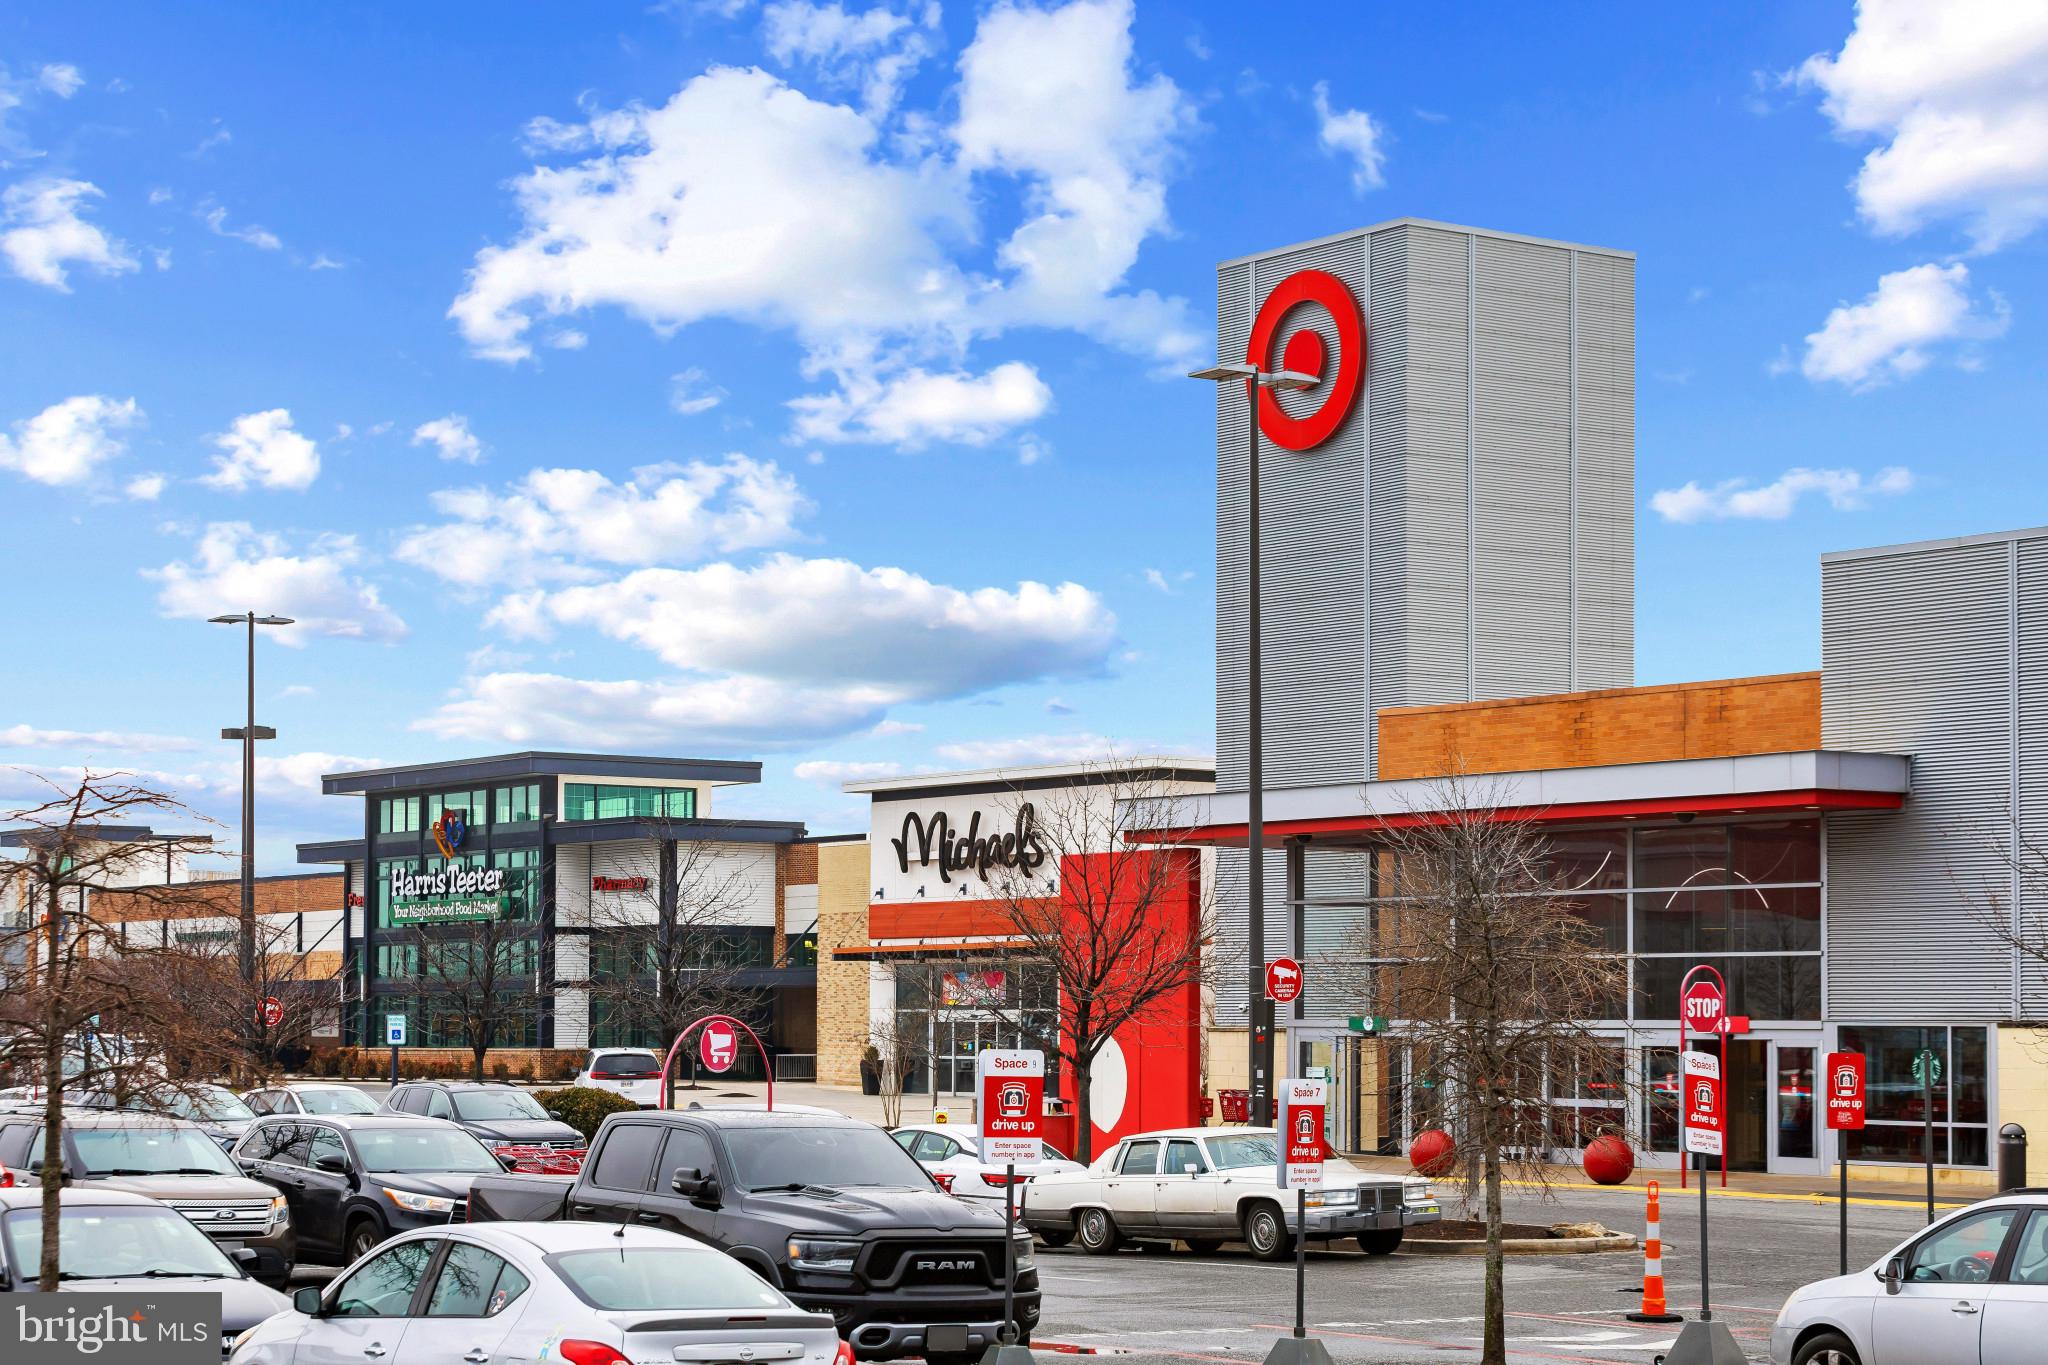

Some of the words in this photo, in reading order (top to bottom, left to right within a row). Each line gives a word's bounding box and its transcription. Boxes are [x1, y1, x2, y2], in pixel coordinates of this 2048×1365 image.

[891, 802, 1044, 883] Michaels
[391, 868, 446, 897] Harris
[447, 864, 503, 894] Teeter
[592, 876, 646, 892] Pharmacy
[393, 904, 409, 918] Your
[409, 902, 454, 920] Neighborhood
[455, 901, 472, 915] Food
[473, 900, 498, 914] Market
[1687, 998, 1720, 1018] STOP
[995, 1057, 1028, 1070] Space
[1032, 1059, 1037, 1069] 9
[1691, 1058, 1711, 1071] Space
[1294, 1087, 1313, 1099] Space
[1315, 1088, 1321, 1097] 7
[1830, 1097, 1850, 1108] drive
[1852, 1099, 1862, 1110] up
[991, 1119, 1019, 1130] drive
[1021, 1121, 1035, 1132] up
[1691, 1112, 1709, 1124] drive
[1709, 1116, 1718, 1126] up
[1013, 1142, 1031, 1150] space
[1292, 1146, 1309, 1157] drive
[1310, 1147, 1320, 1158] up
[1023, 1151, 1035, 1159] app
[917, 1260, 975, 1270] RAM
